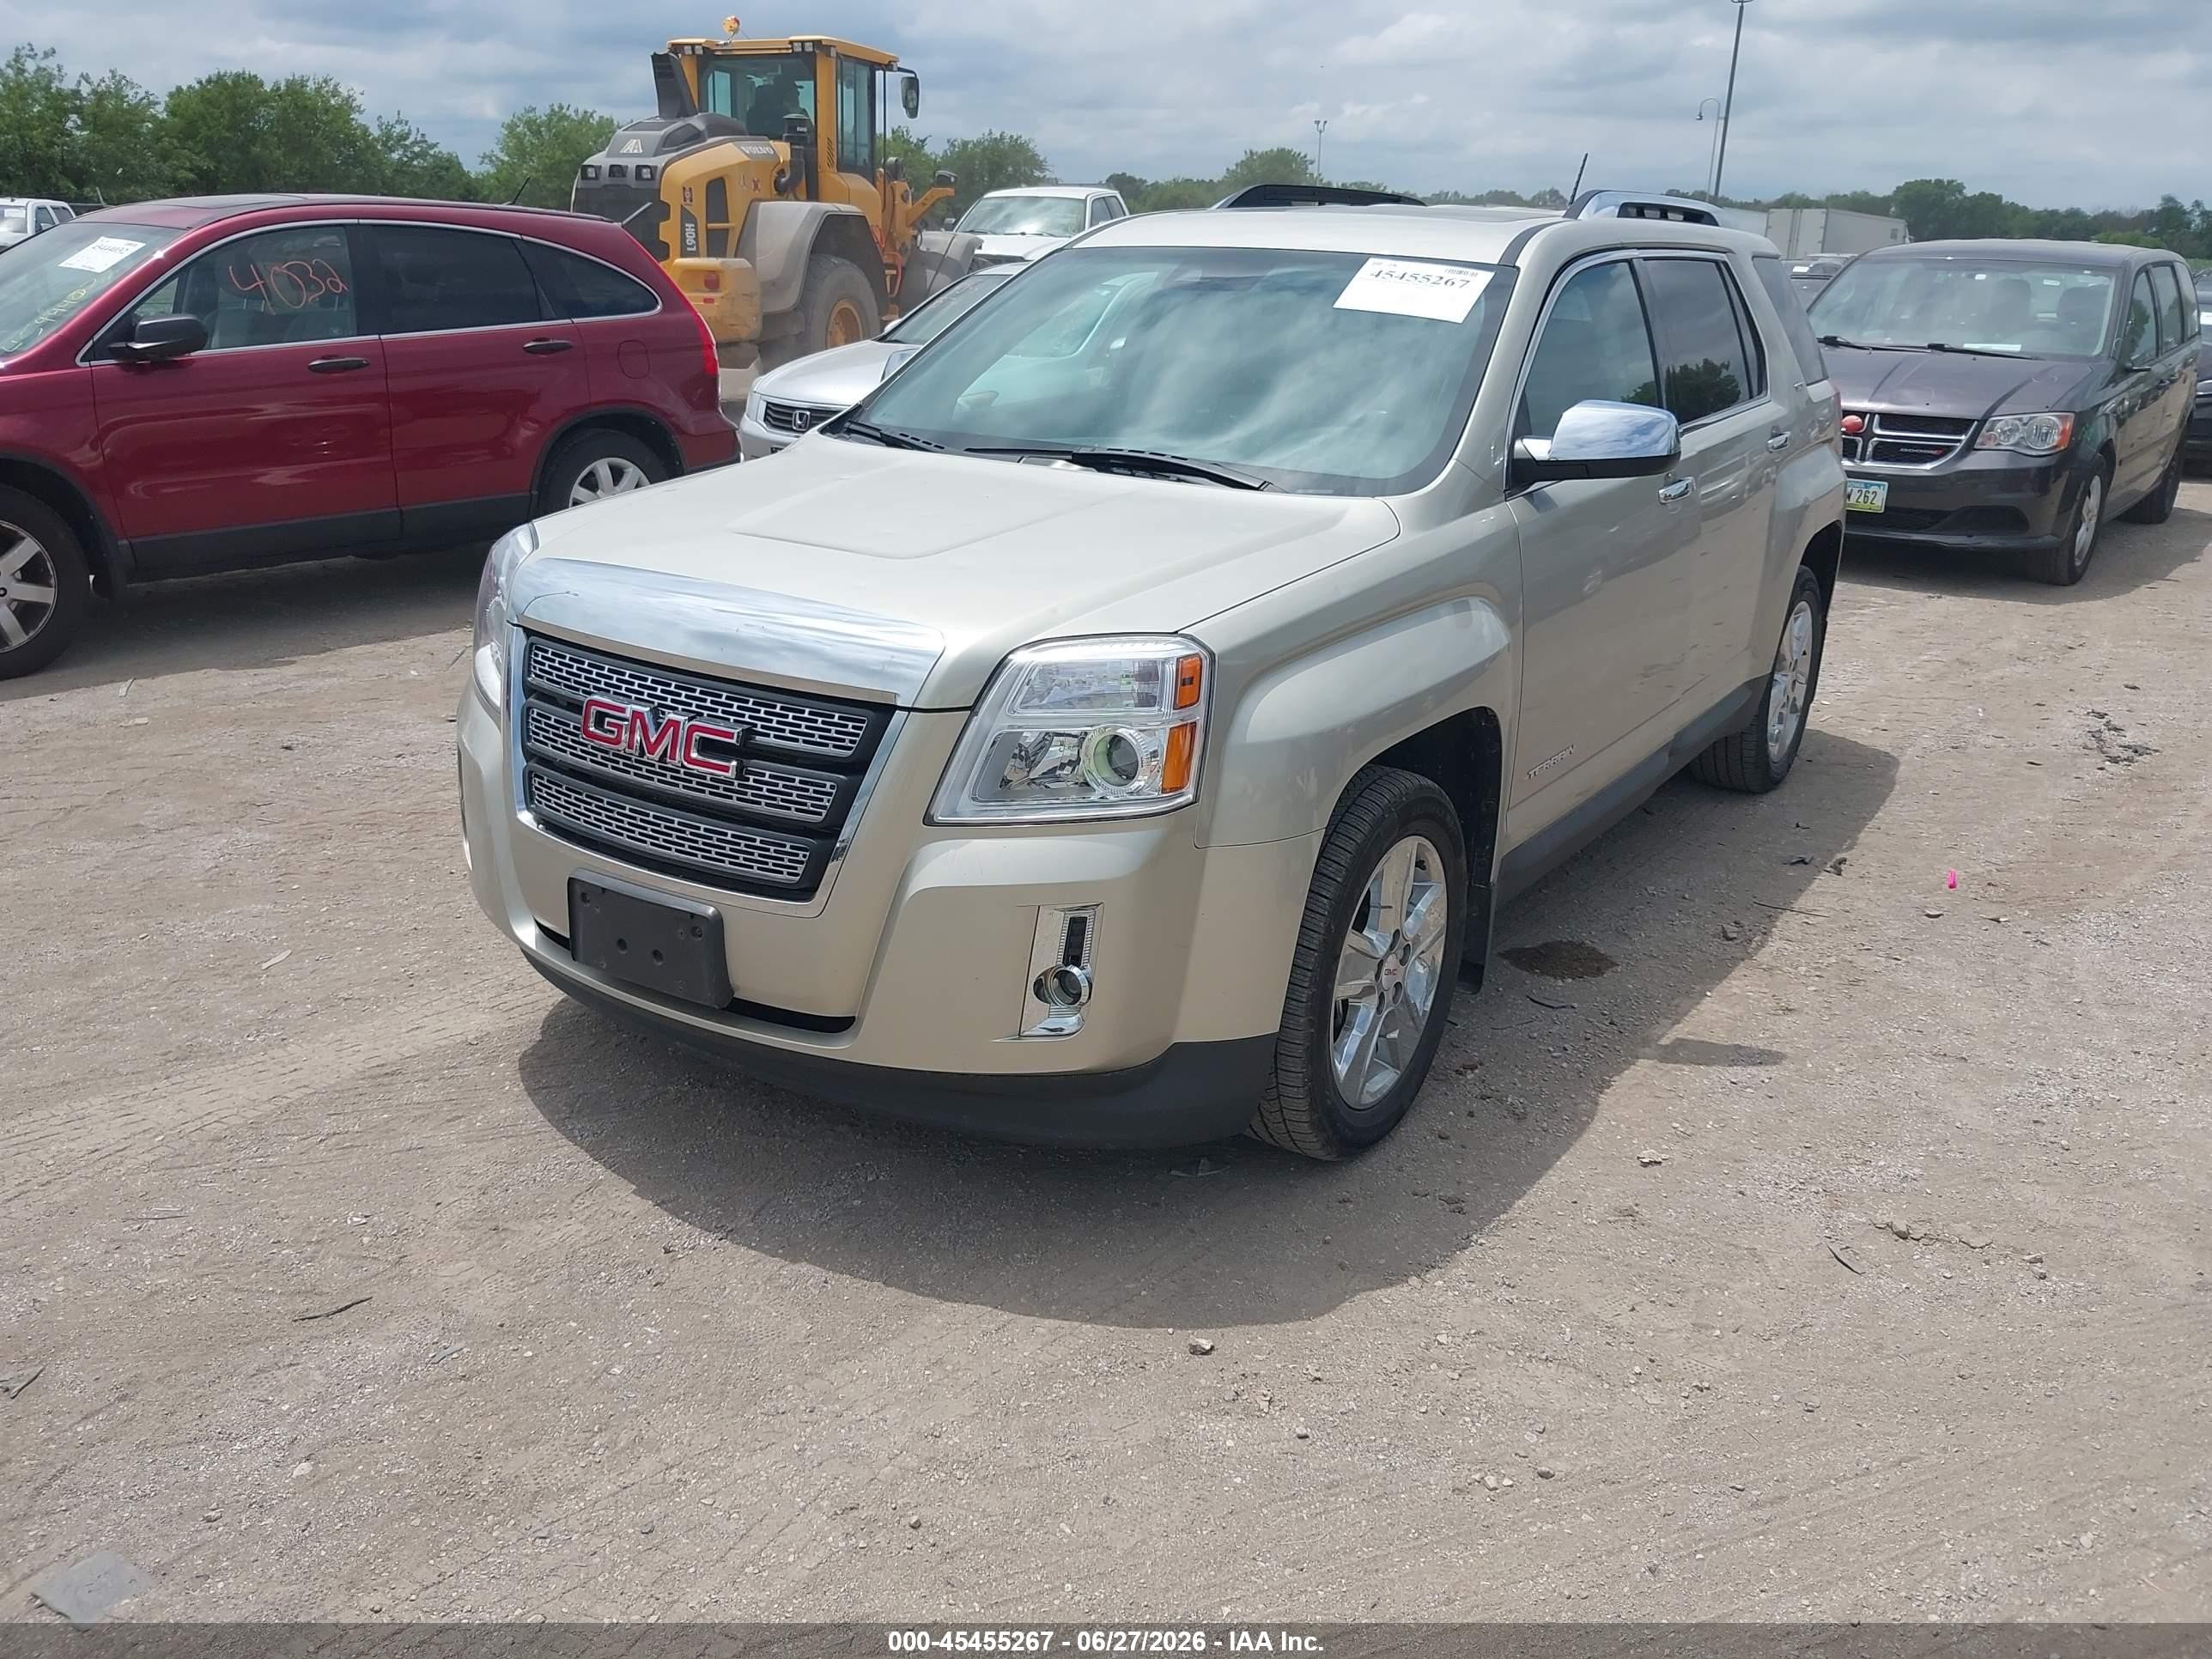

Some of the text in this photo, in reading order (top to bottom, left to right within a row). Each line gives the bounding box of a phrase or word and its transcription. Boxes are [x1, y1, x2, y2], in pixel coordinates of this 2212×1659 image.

[741, 145, 775, 155] VOLVO
[685, 223, 697, 252] L90H
[228, 258, 349, 315] 4032
[1370, 270, 1471, 289] 45455267
[1856, 489, 1878, 505] 262
[581, 693, 744, 779] GMC
[1526, 743, 1577, 781] TERRAIN
